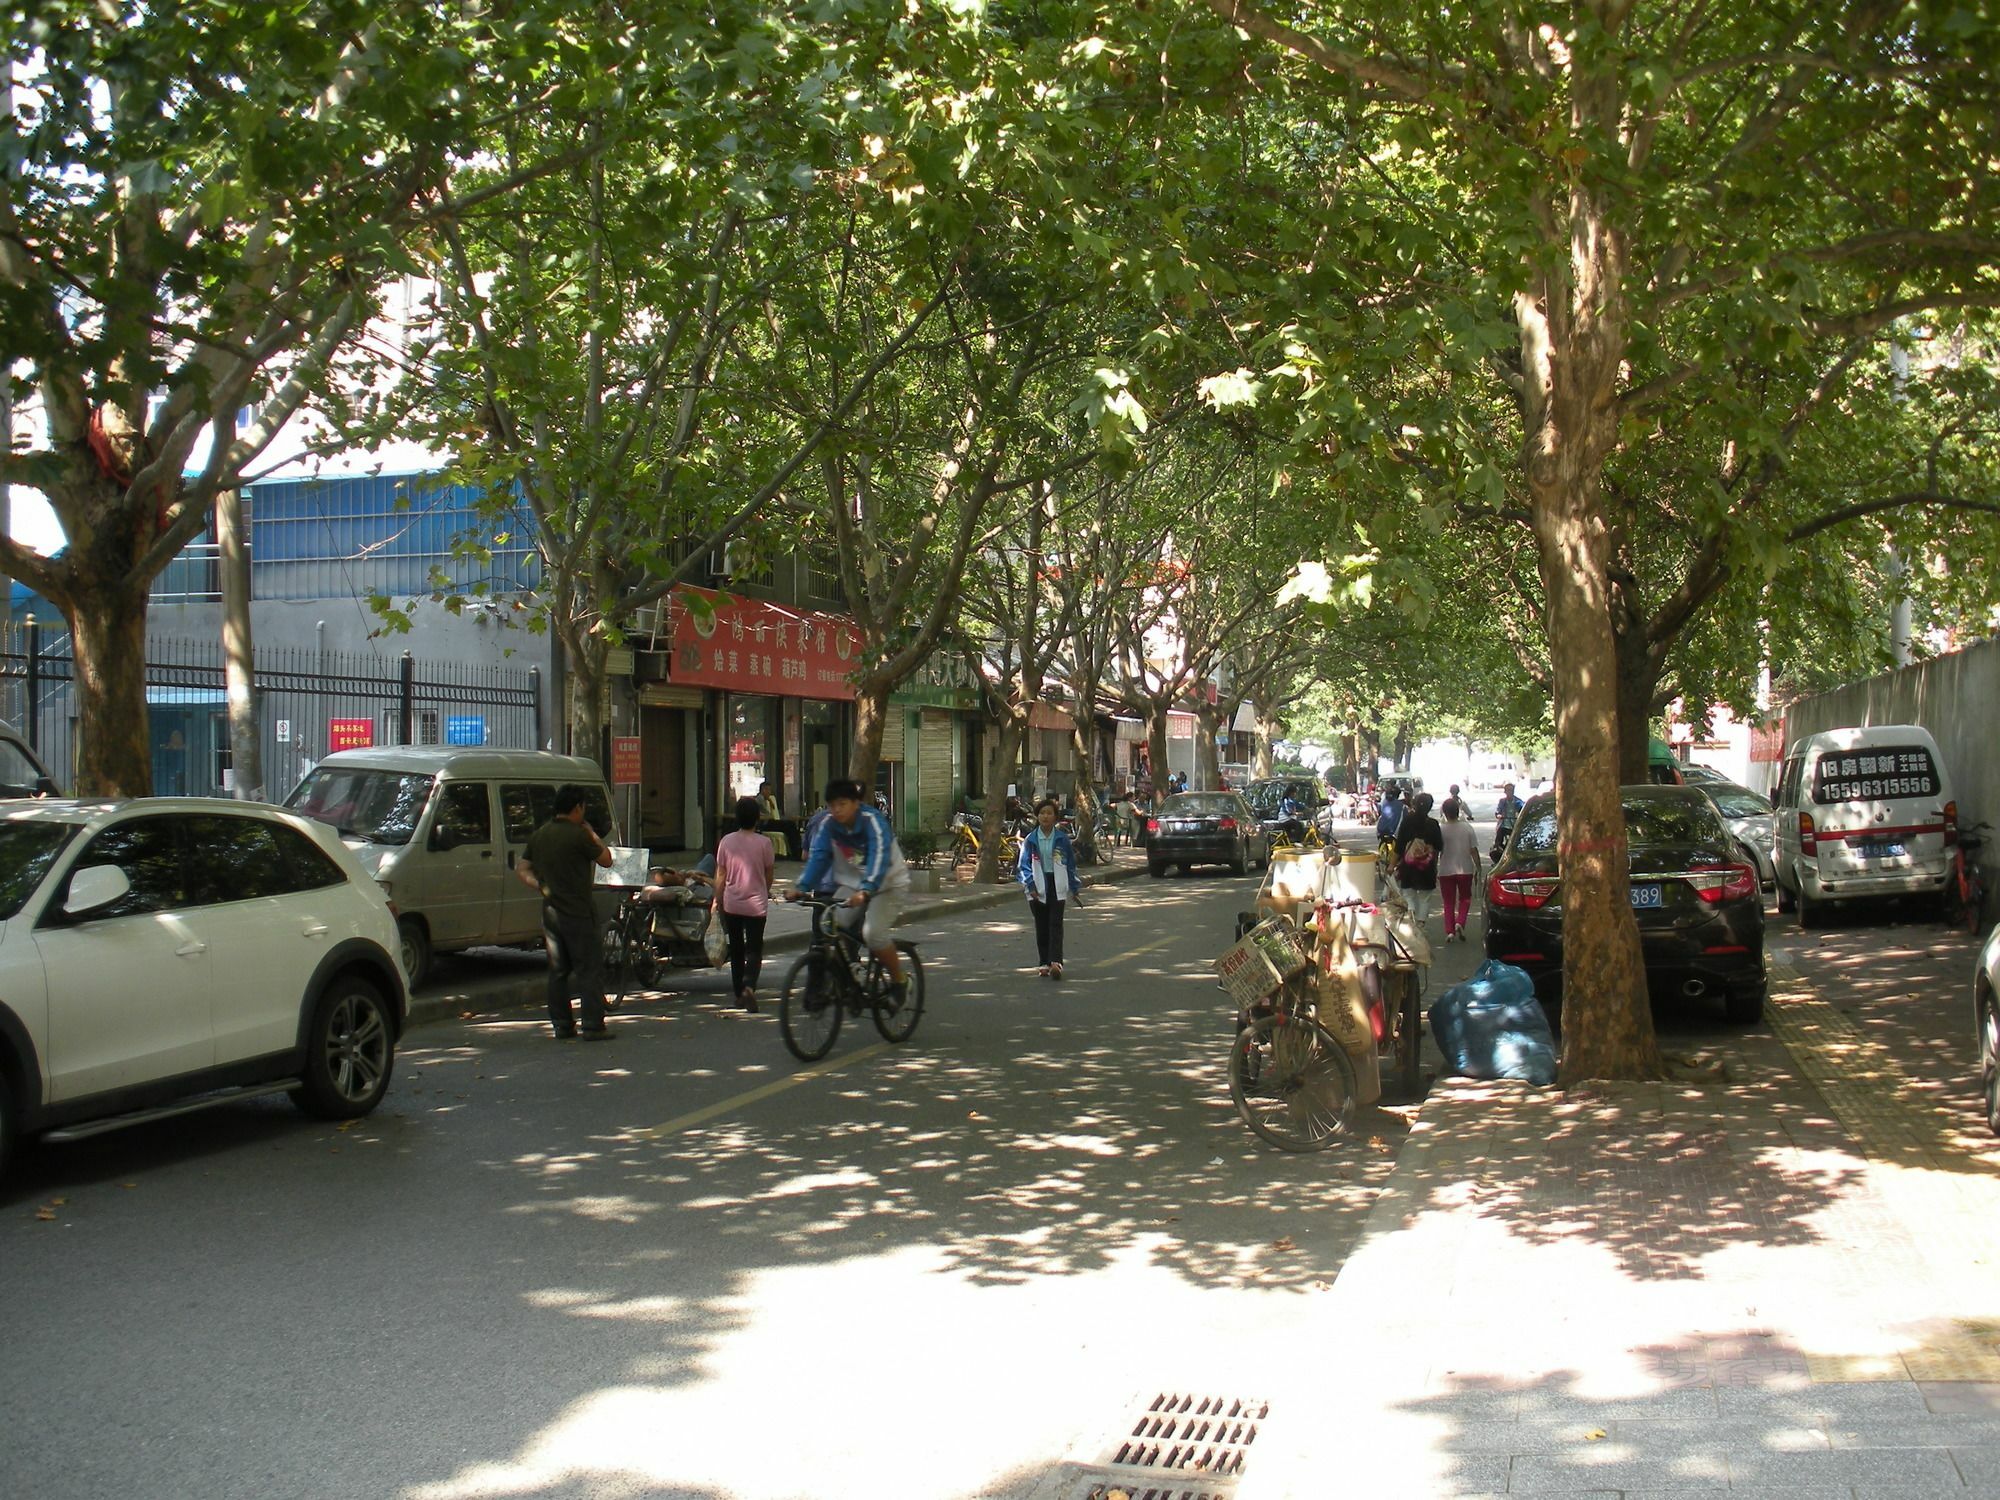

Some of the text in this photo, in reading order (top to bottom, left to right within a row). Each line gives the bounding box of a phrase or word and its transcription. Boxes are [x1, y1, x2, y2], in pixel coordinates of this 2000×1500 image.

[1821, 755, 1895, 778] 旧房翻新
[1822, 777, 1931, 800] 15596315556
[1630, 887, 1660, 905] 389
